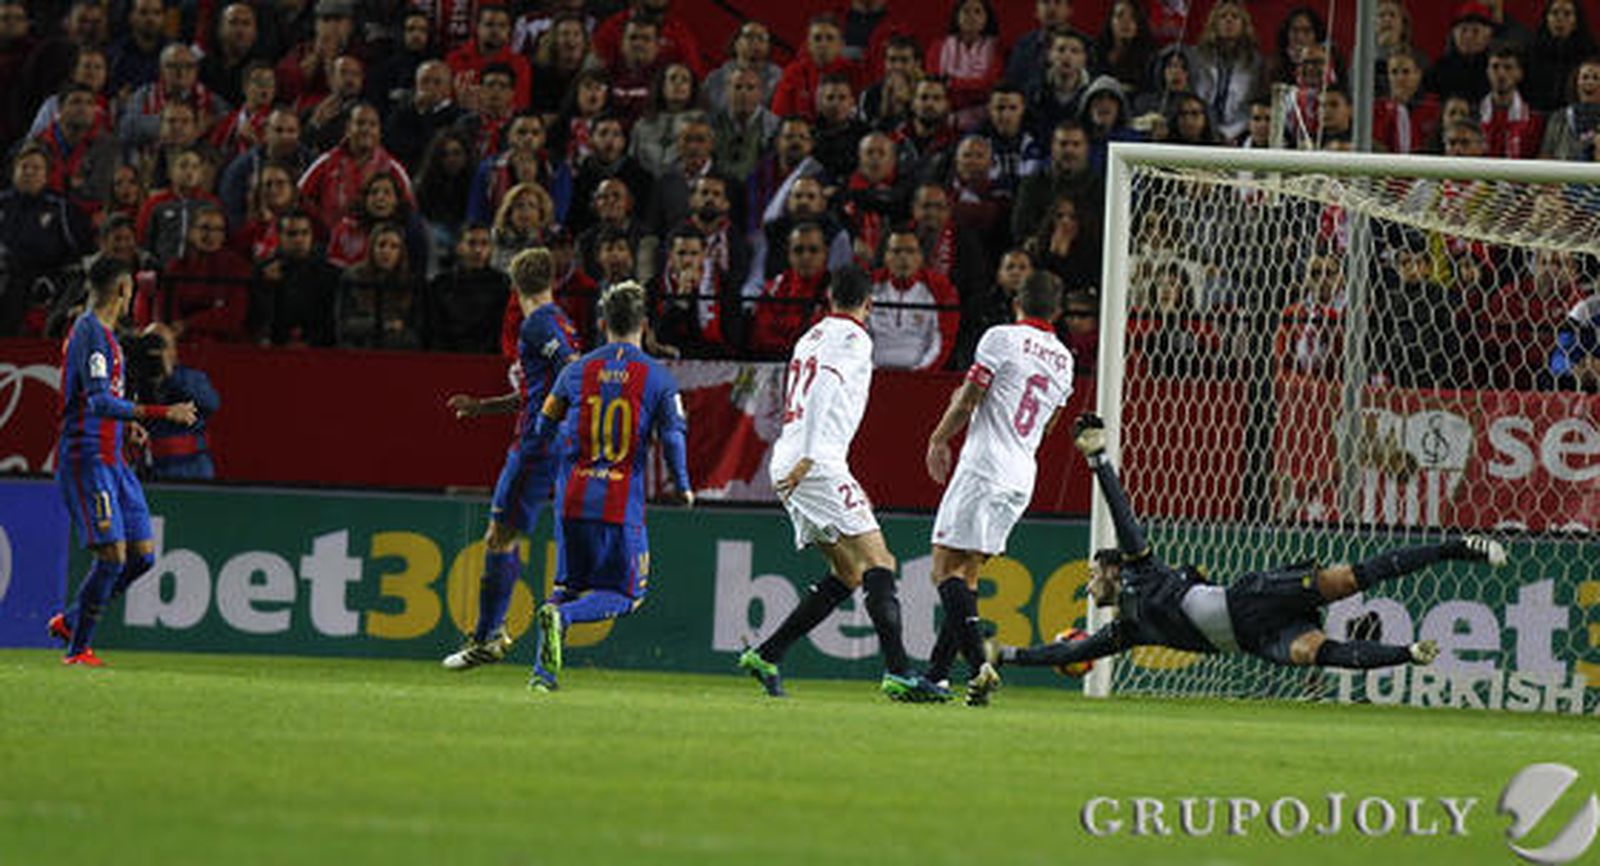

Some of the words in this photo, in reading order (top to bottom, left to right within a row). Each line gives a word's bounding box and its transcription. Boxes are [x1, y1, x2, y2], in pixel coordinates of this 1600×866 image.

[587, 395, 632, 463] 10
[1014, 373, 1049, 438] 6
[1323, 664, 1586, 716] TURKISH
